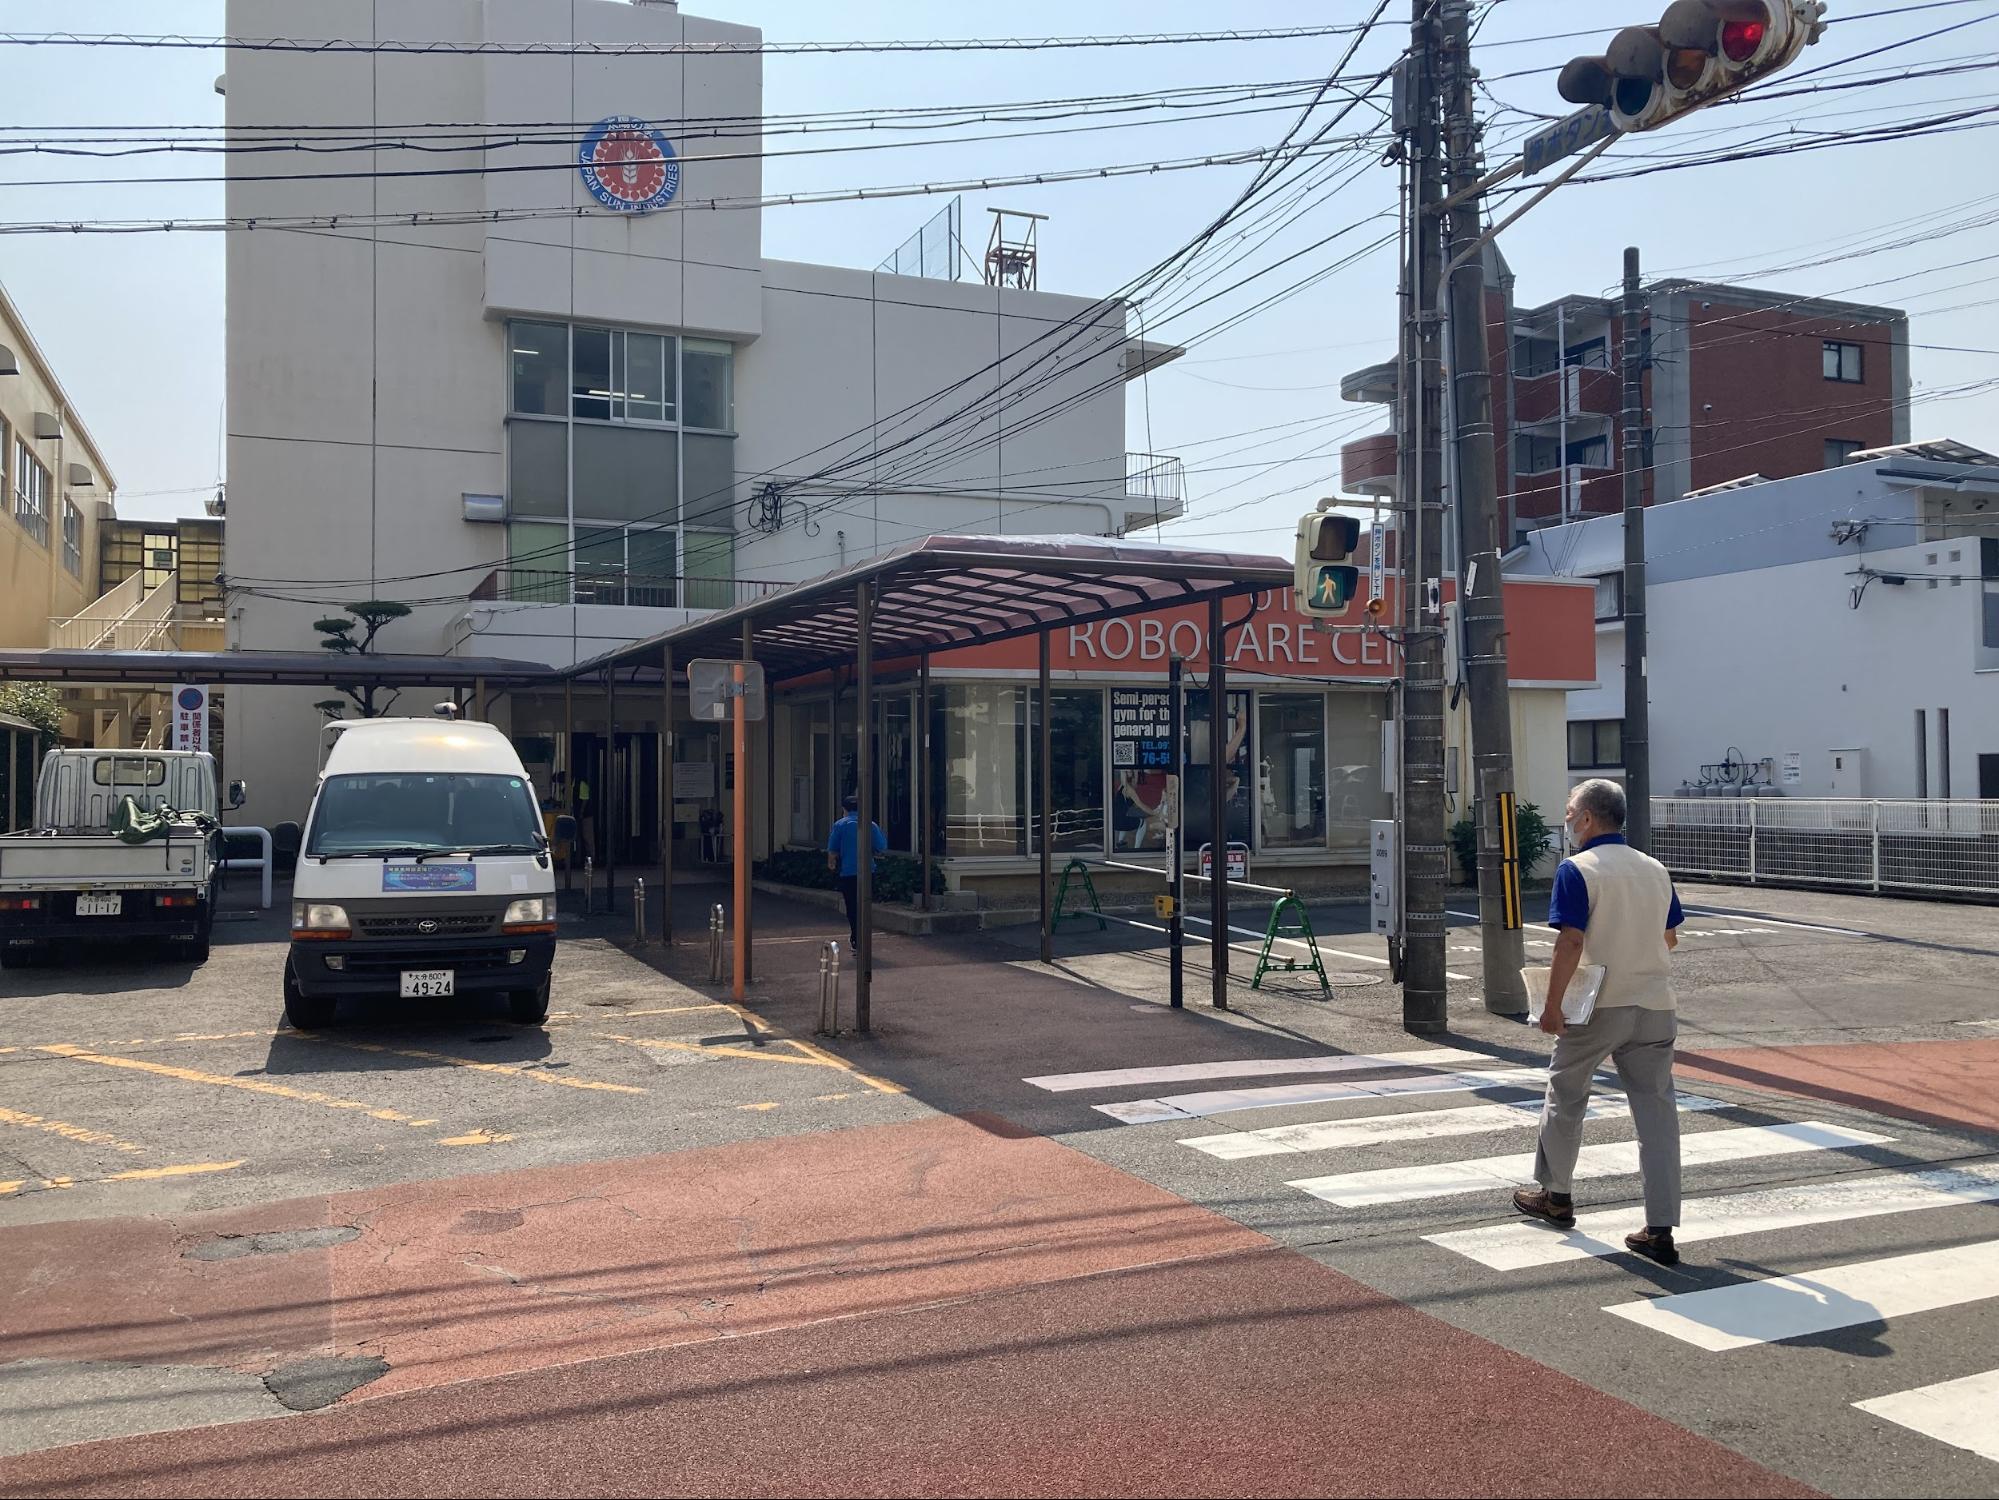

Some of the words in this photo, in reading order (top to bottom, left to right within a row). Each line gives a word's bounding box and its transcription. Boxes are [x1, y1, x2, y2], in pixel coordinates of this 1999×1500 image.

[581, 151, 600, 191] JAPAN
[599, 191, 625, 210] SUN
[1069, 617, 1319, 664] ROBOARE
[1113, 709, 1136, 723] gym
[1139, 707, 1156, 721] for
[412, 980, 451, 996] 49-24
